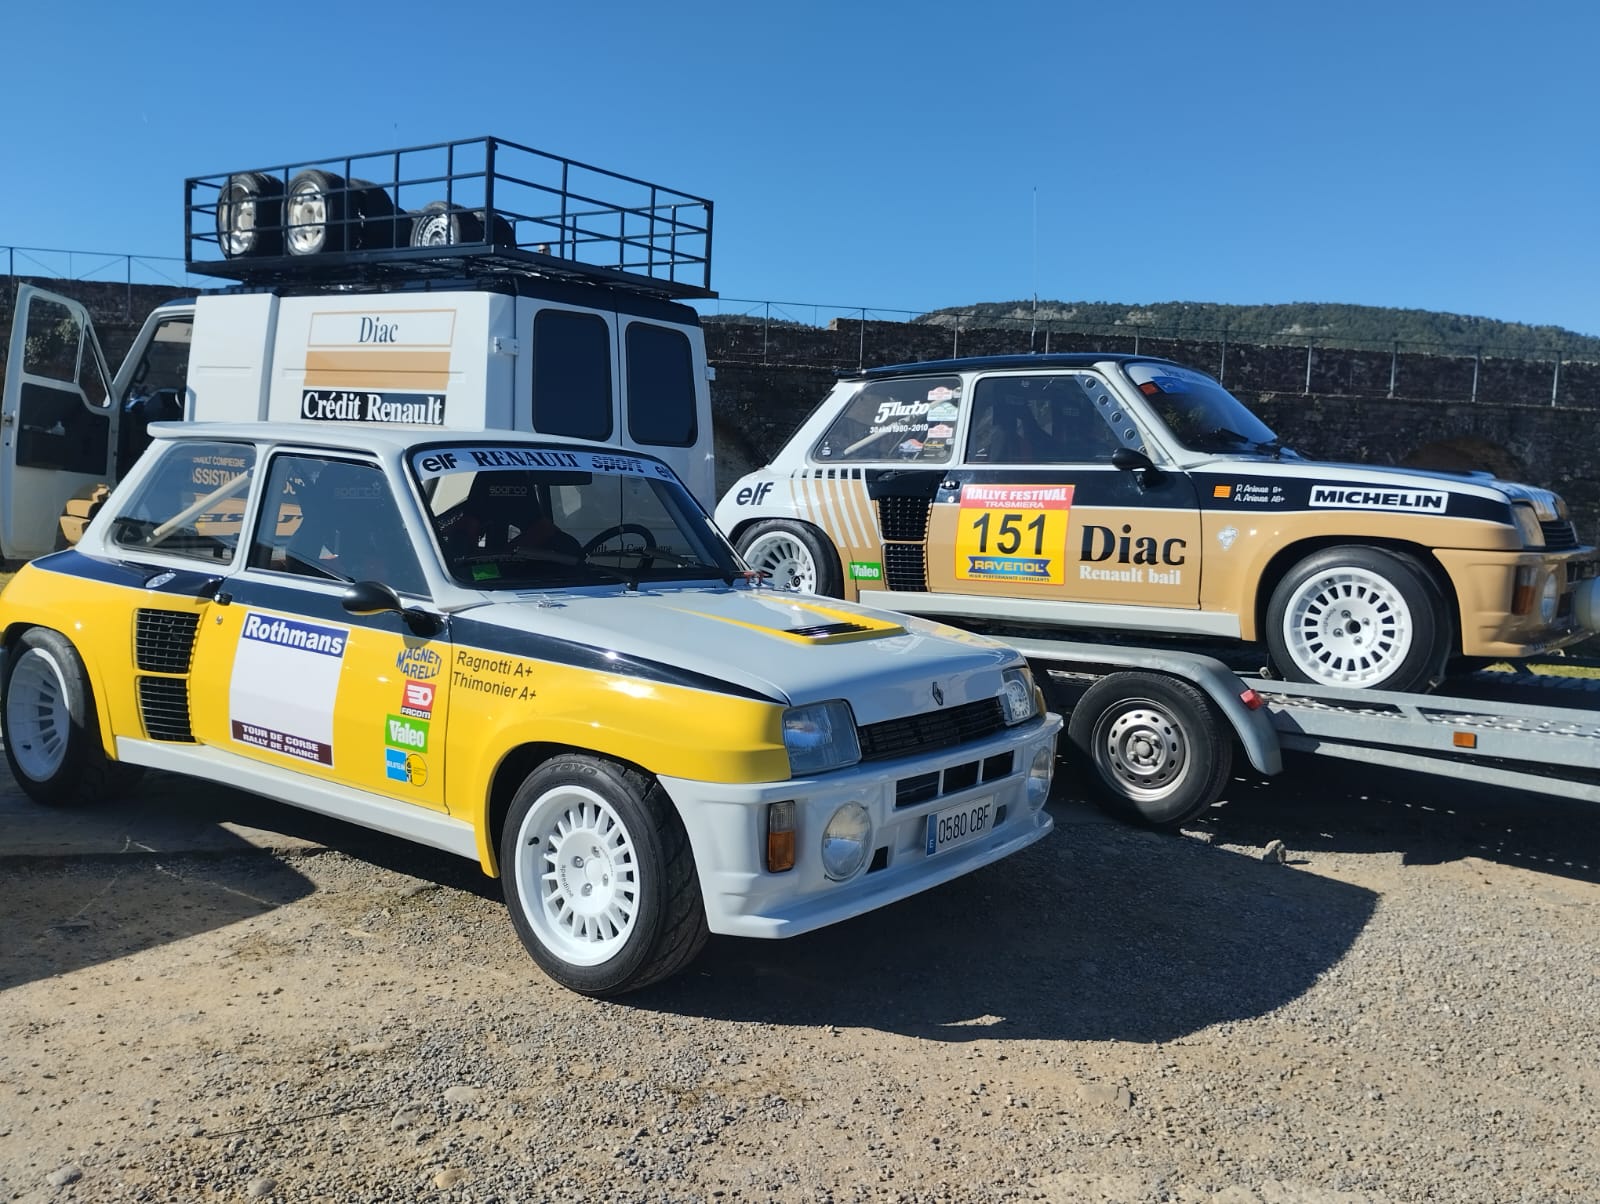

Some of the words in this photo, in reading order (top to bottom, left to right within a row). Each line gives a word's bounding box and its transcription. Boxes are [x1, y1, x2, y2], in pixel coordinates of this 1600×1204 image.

[358, 316, 398, 343] Diac
[303, 391, 362, 419] Crédit
[366, 394, 442, 425] Renault
[422, 453, 458, 472] elf
[469, 451, 581, 468] RENAULT
[592, 455, 645, 474] sport
[736, 482, 773, 505] elf
[966, 487, 1007, 501] RALLYE
[1010, 487, 1067, 501] FESTIVAL
[984, 501, 1044, 509] TRASMIERA
[1313, 489, 1443, 509] MICHELIN
[972, 512, 1046, 556] 151
[1079, 524, 1187, 566] Diac
[851, 563, 879, 578] Valeo
[974, 560, 1044, 573] RAVENOL
[1080, 566, 1143, 583] Renault
[1148, 568, 1181, 585] bail
[245, 615, 344, 655] Rothmans
[456, 650, 513, 675] Ragnotti
[514, 663, 533, 678] A+
[453, 671, 518, 698] Thimonier
[519, 686, 537, 700] A+
[401, 707, 431, 719] FACOM
[242, 725, 268, 739] TOUR
[270, 732, 283, 742] DE
[285, 736, 319, 752] CORSE
[389, 719, 425, 748] Valeo
[243, 734, 268, 747] RALLY
[270, 740, 283, 750] DE
[284, 745, 320, 761] FRANCE
[929, 839, 934, 849] E
[938, 812, 967, 844] 0580
[969, 803, 991, 832] CBF
